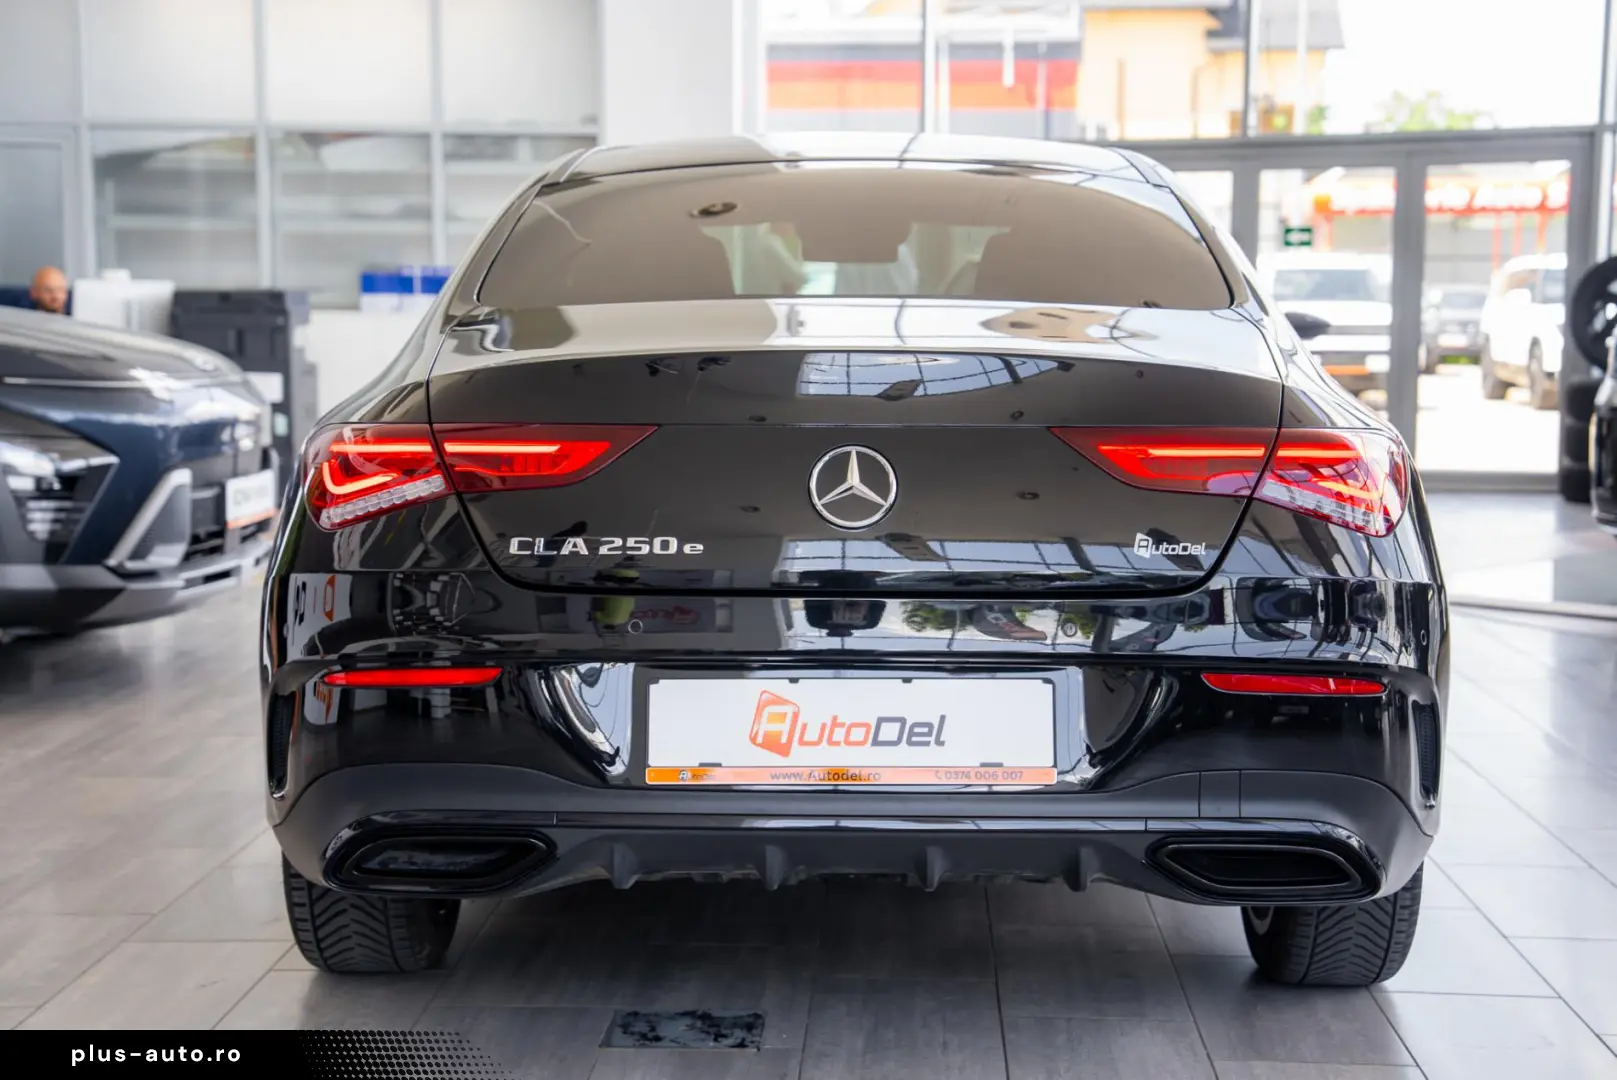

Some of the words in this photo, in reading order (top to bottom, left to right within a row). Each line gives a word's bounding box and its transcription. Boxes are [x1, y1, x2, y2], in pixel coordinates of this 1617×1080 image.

[509, 536, 588, 556] CLA
[1133, 532, 1206, 558] AutoDel
[749, 690, 947, 758] AutoDel
[769, 767, 882, 781] www.Autodel.ro
[944, 770, 971, 780] 0374
[975, 770, 999, 780] 006
[1001, 770, 1024, 780] 007
